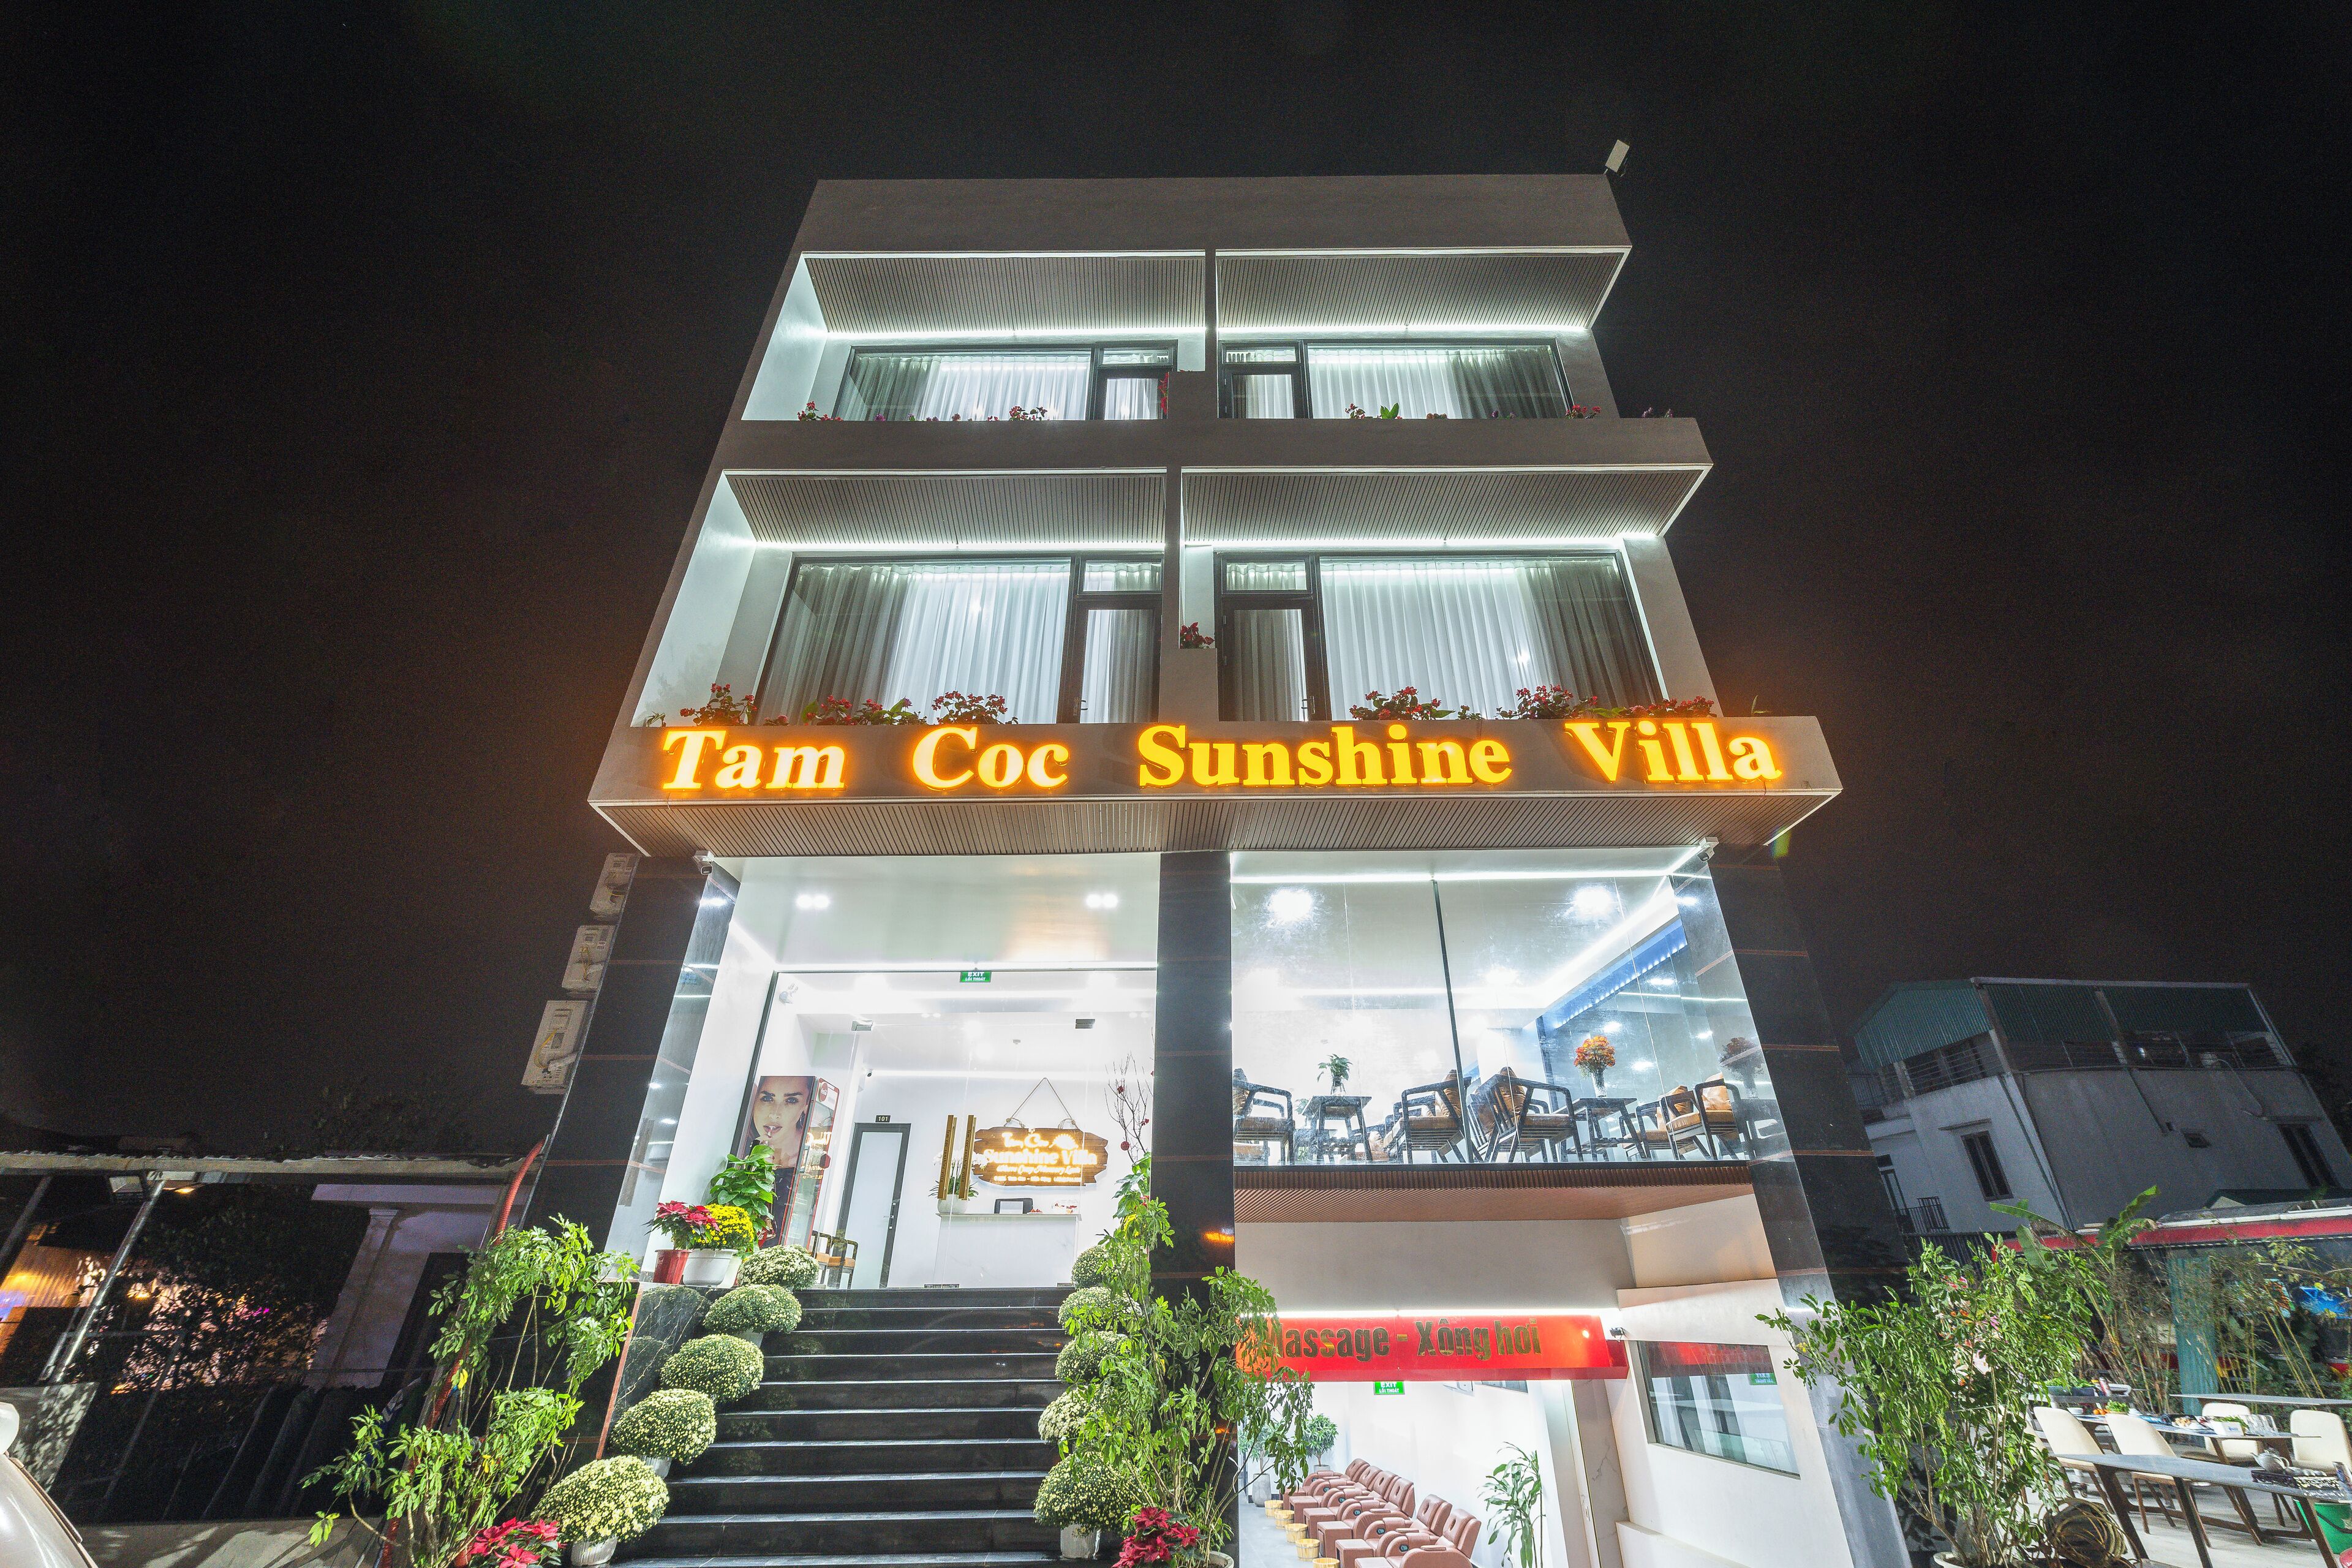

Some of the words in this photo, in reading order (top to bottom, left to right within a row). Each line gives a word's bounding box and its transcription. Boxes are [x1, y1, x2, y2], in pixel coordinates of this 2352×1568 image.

[662, 729, 846, 791] Tam
[911, 727, 1069, 790] Coc
[1137, 725, 1512, 788] Sunshine
[1564, 722, 1784, 783] Villa
[1415, 1318, 1492, 1361] Xông
[1493, 1318, 1542, 1355] hơi
